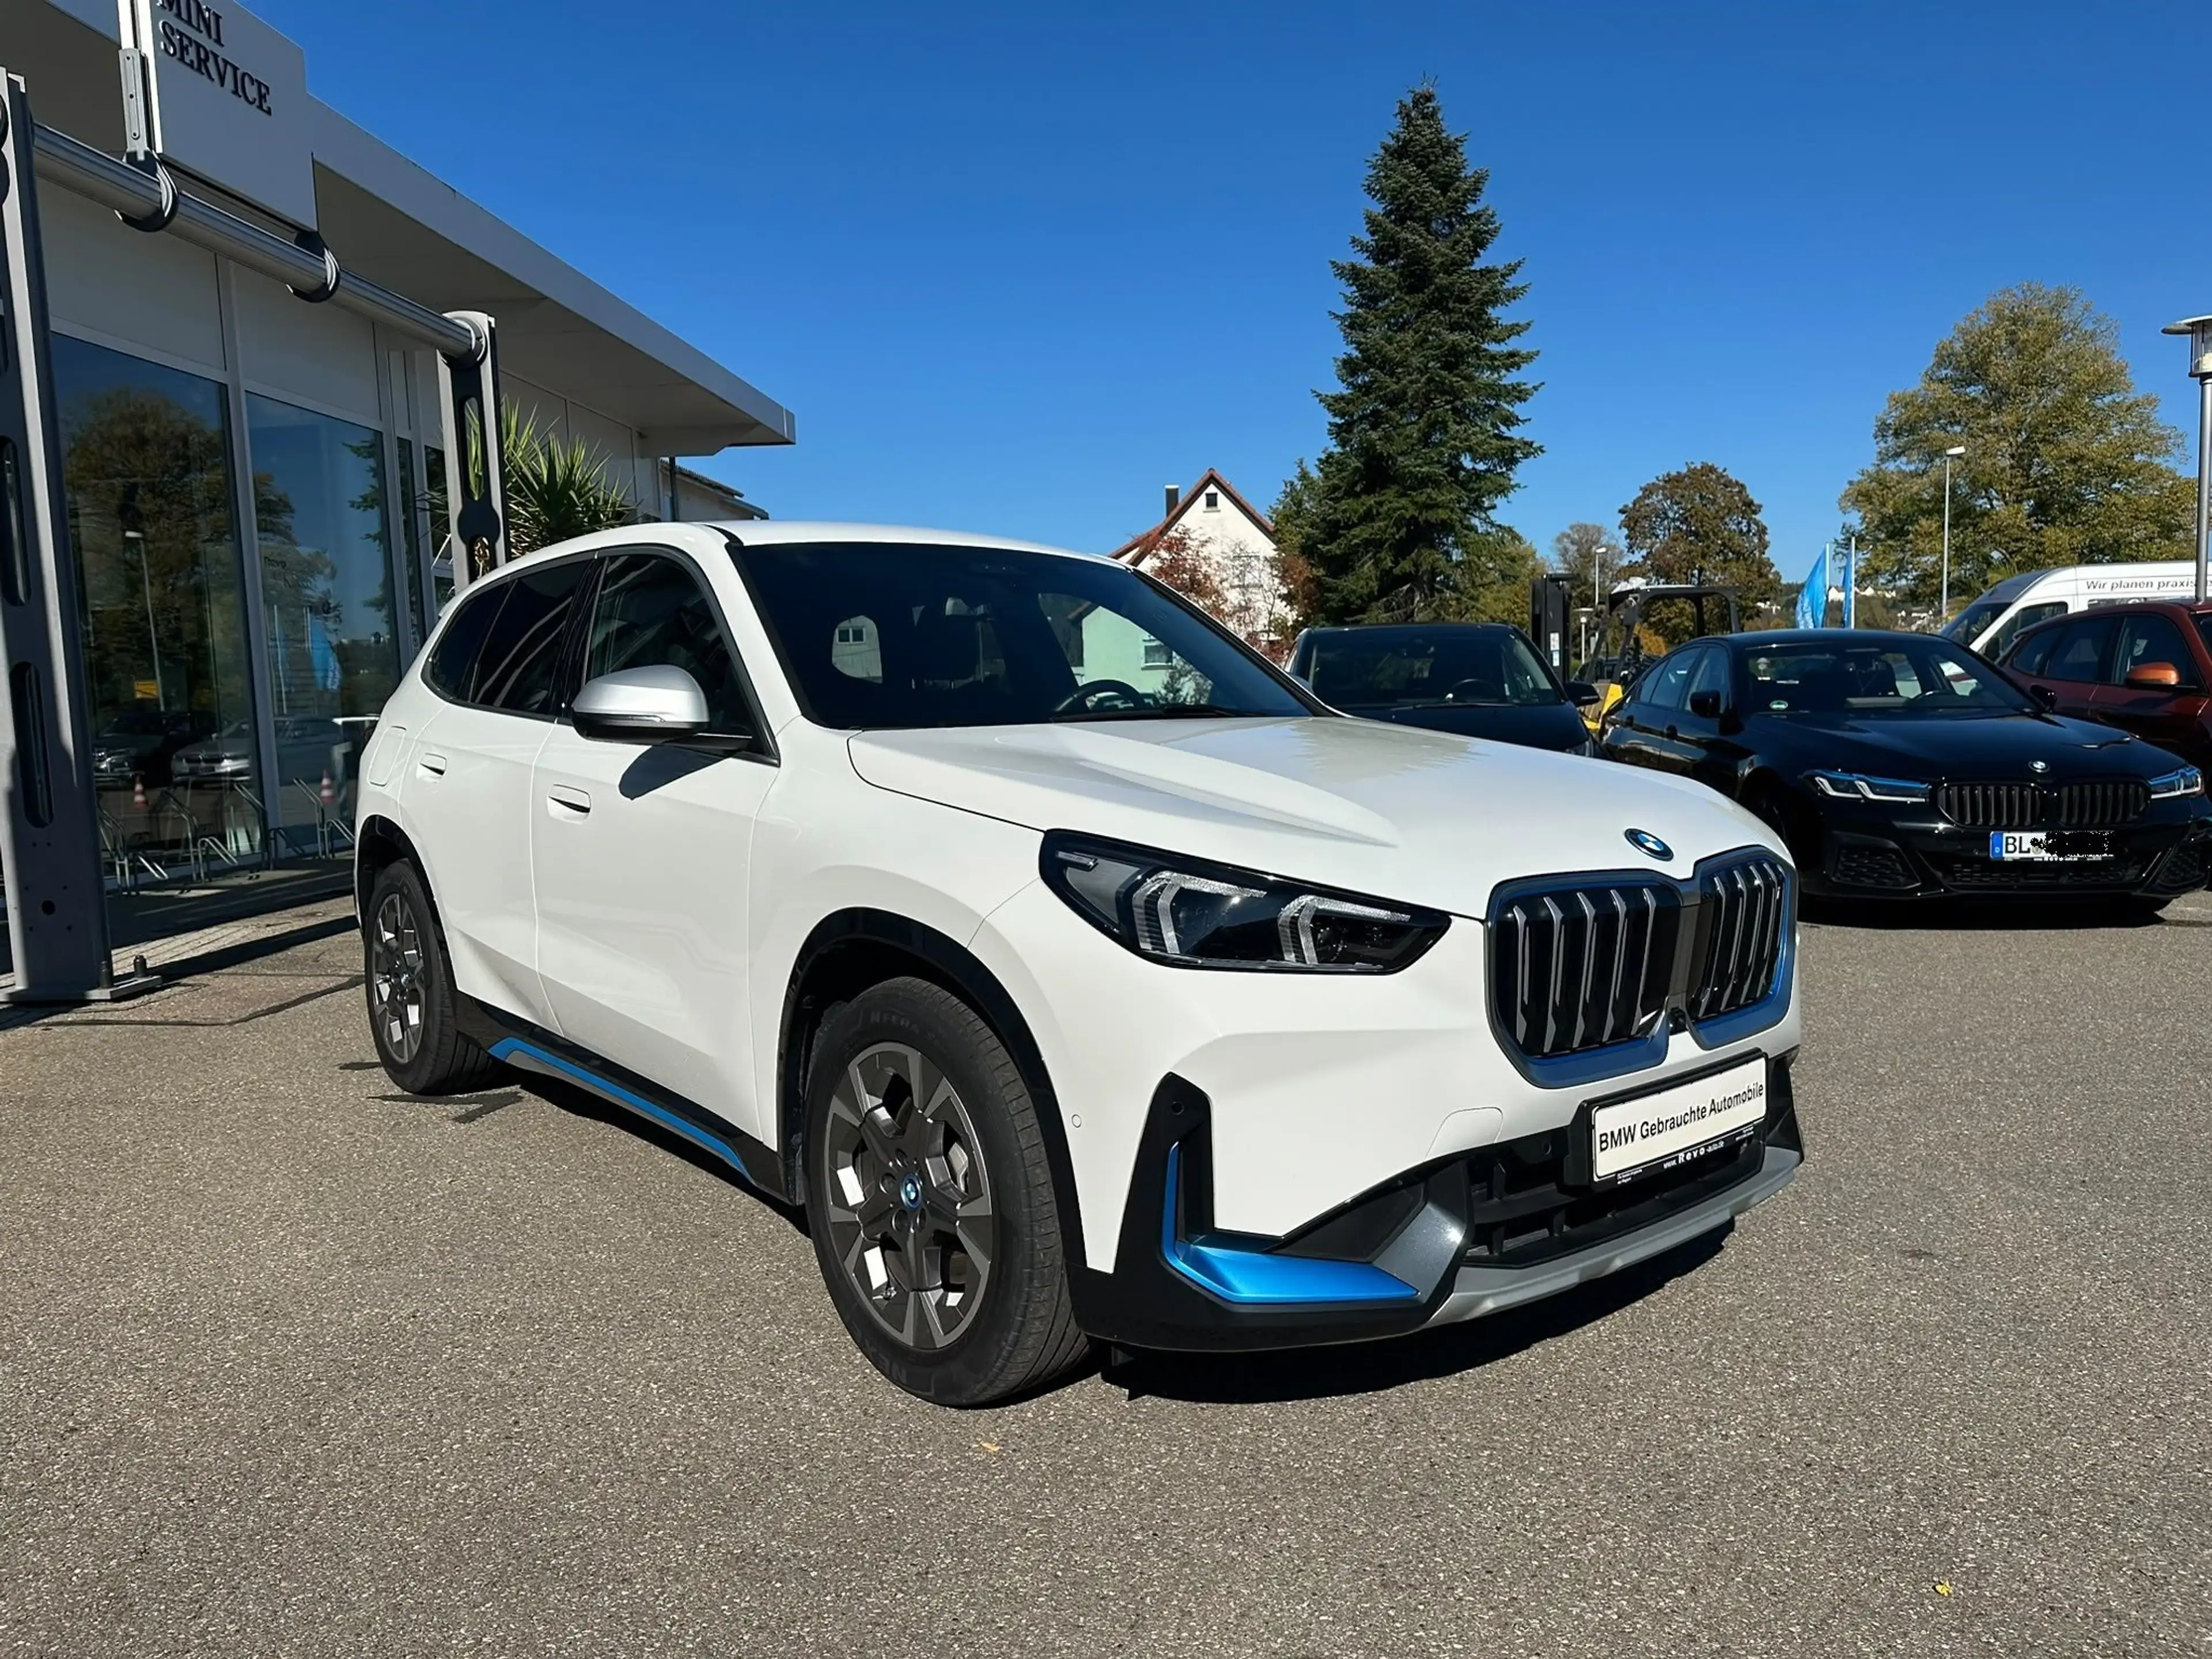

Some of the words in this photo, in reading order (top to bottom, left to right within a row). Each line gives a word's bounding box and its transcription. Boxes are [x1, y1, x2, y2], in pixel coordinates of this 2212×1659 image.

[158, 20, 272, 116] SERVICE
[2086, 581, 2107, 590] Wir
[2110, 579, 2153, 592] planen
[2005, 836, 2030, 854] BL
[1599, 1124, 1636, 1152] BMW
[1641, 1105, 1707, 1139] Gebrauchte
[1709, 1082, 1764, 1116] Automobile
